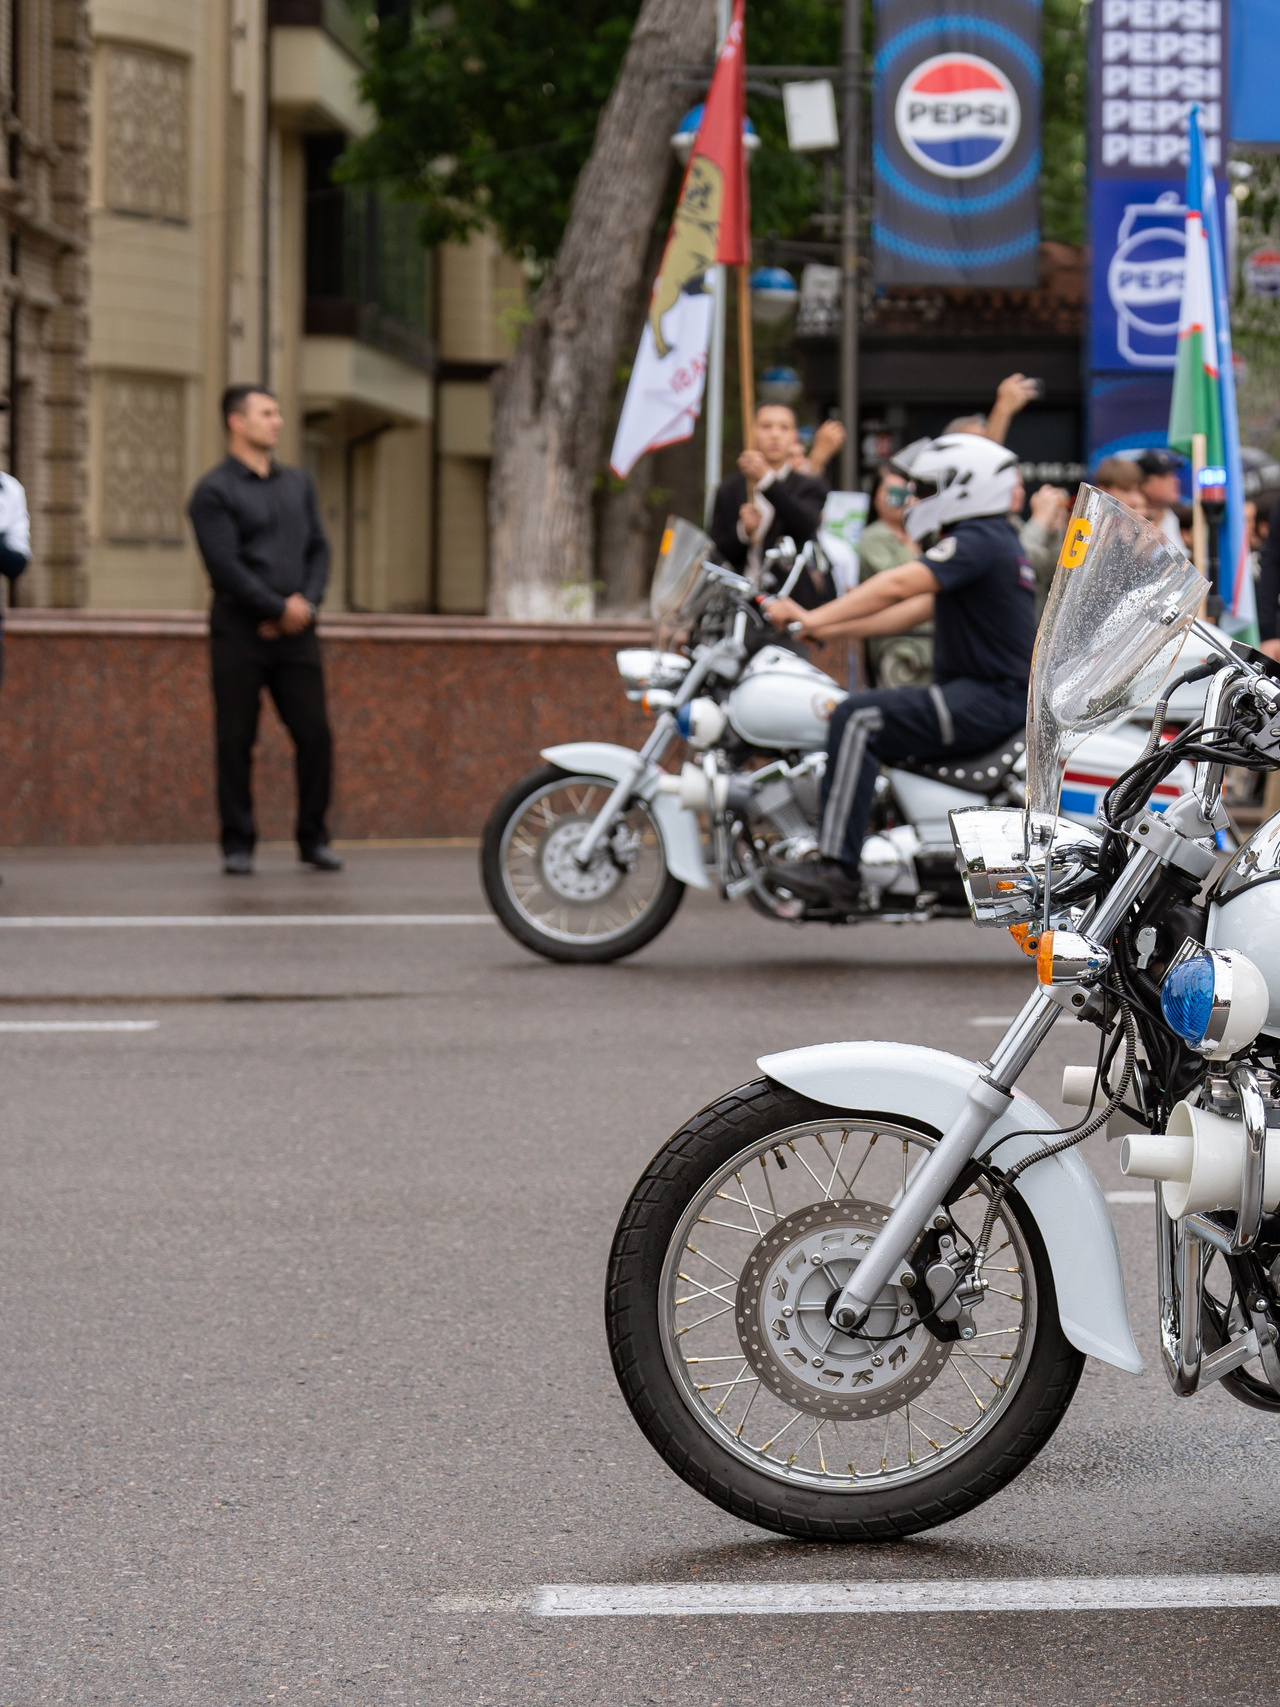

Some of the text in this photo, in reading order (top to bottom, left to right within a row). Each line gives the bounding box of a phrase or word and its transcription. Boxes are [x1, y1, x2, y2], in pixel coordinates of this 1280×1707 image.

[1101, 0, 1222, 30] PEPSI
[1102, 31, 1221, 63] PEPSI
[1102, 65, 1221, 98] PEPSI
[908, 102, 1009, 125] PEPSI
[1102, 99, 1221, 131] PEPSI
[1058, 516, 1092, 568] G
